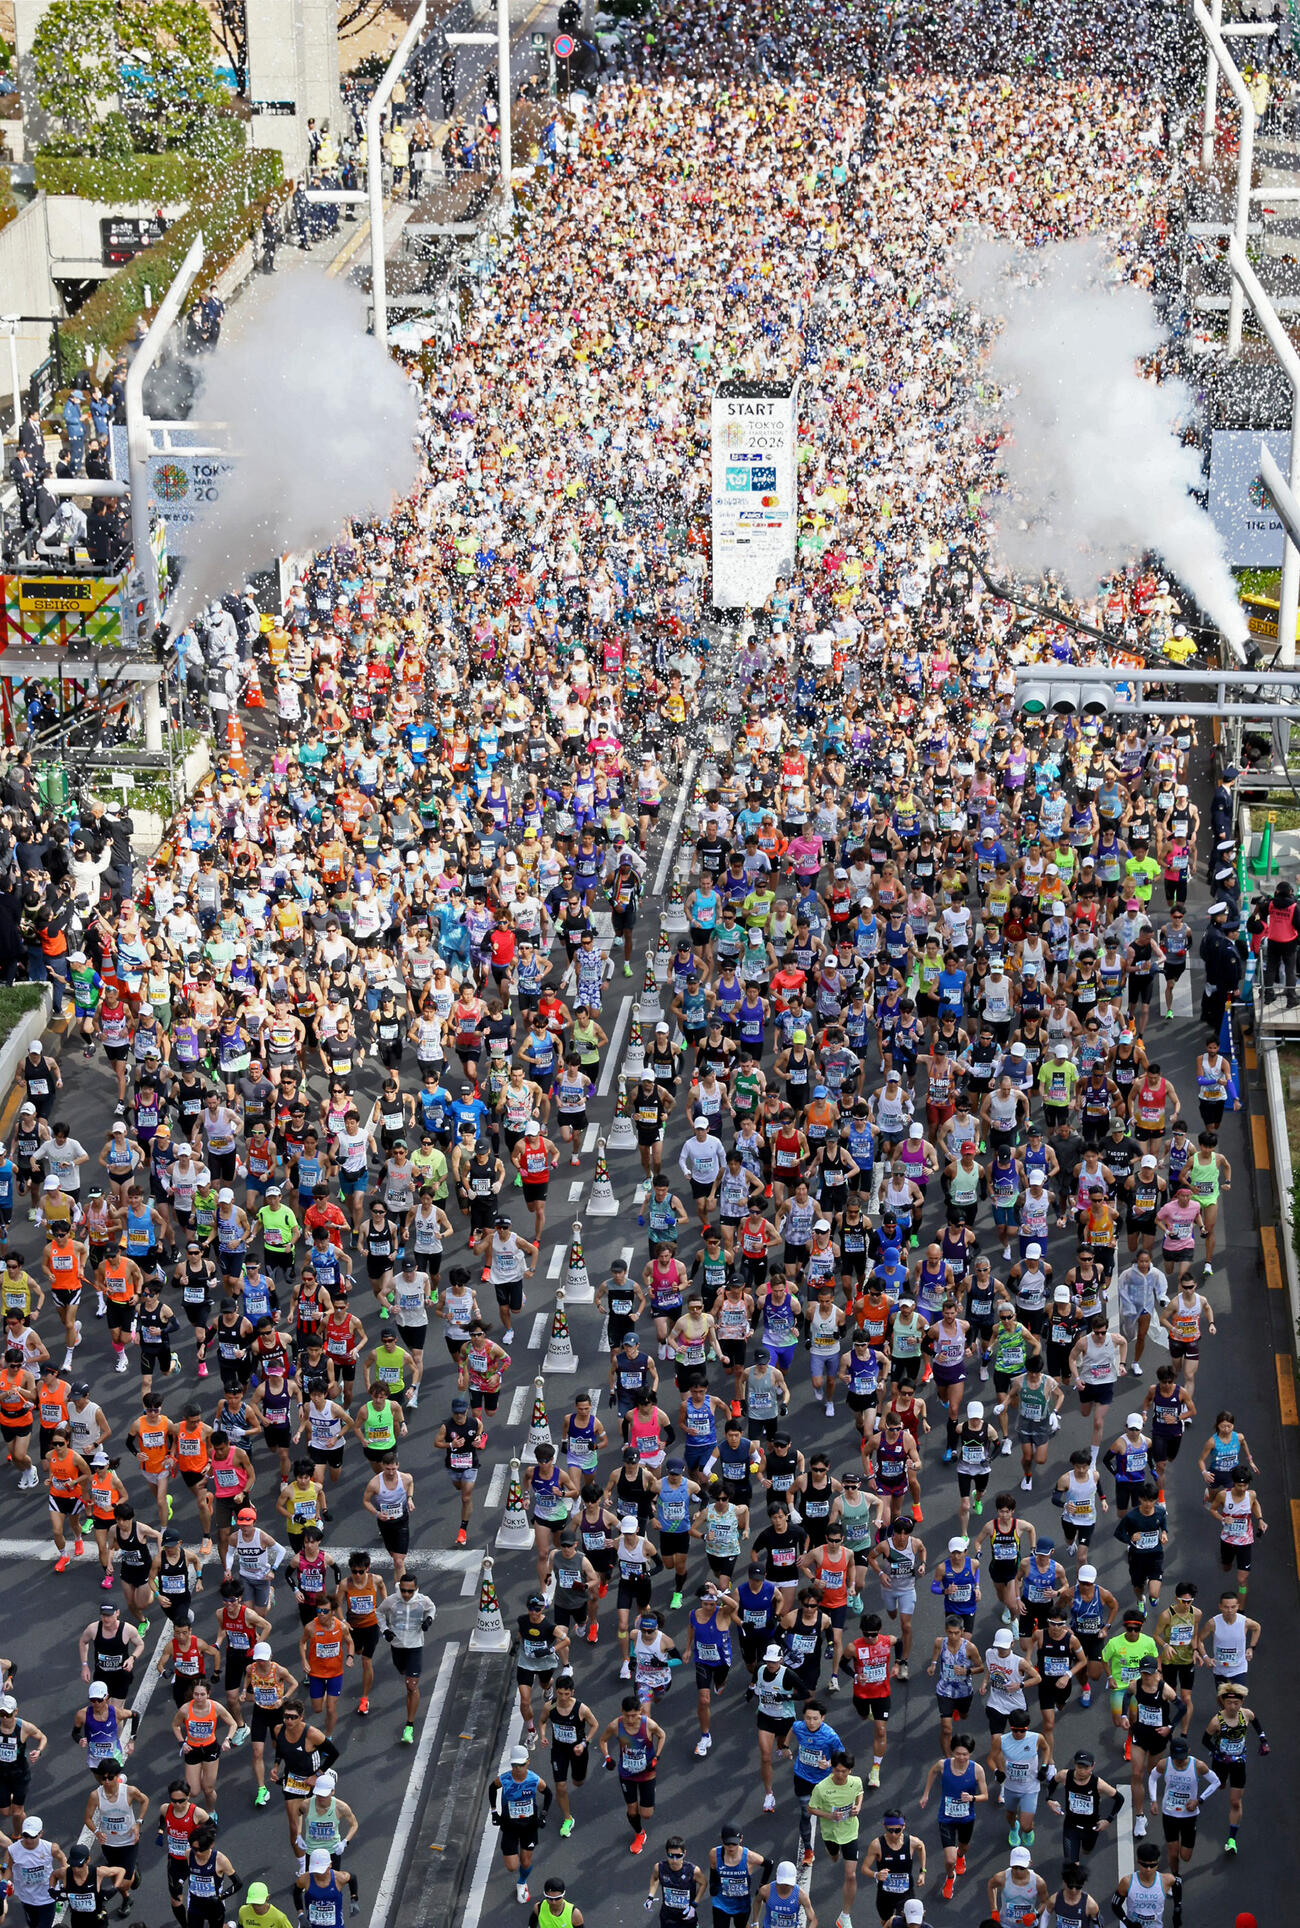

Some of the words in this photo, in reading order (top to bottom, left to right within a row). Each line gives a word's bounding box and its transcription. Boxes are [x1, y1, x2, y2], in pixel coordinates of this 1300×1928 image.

[728, 404, 774, 415] START
[749, 437, 784, 448] 2026
[195, 488, 219, 501] 20
[1270, 522, 1284, 530] DA
[34, 600, 80, 610] SEIKO
[530, 1433, 549, 1441] TOKYO
[504, 1517, 526, 1525] TOKYO
[477, 1618, 500, 1627] TOKYO
[1073, 1799, 1089, 1807] 21524
